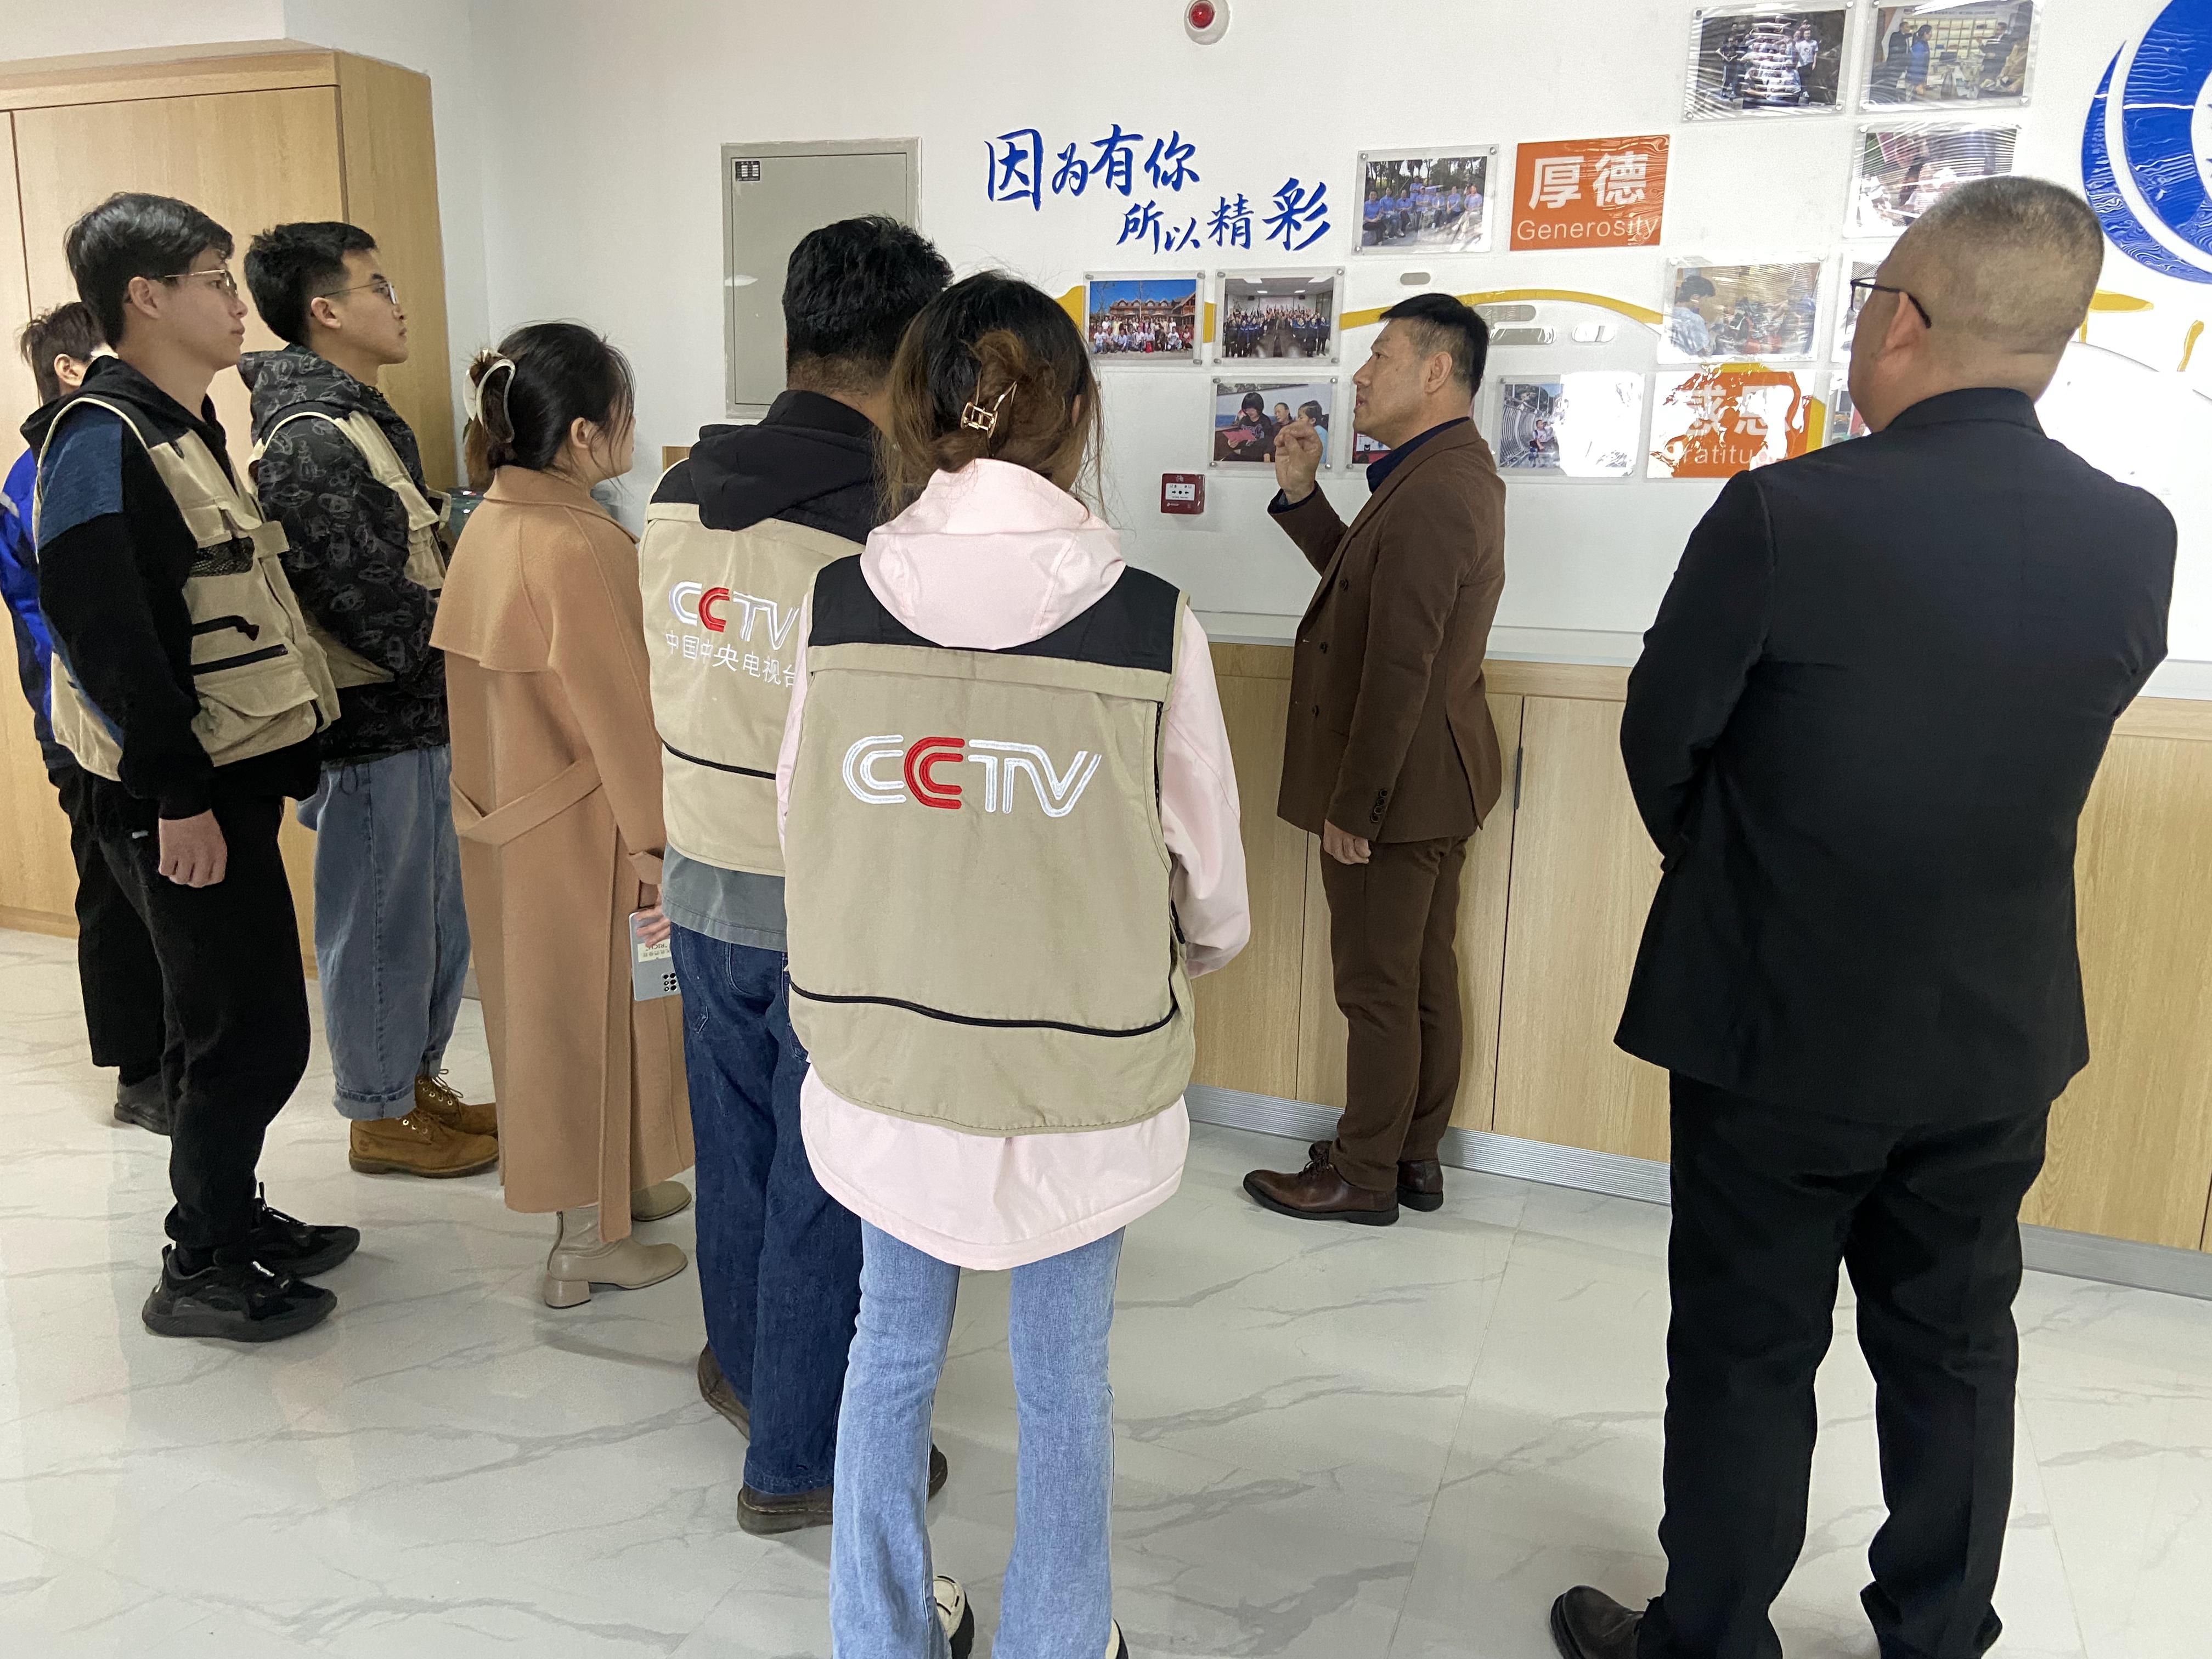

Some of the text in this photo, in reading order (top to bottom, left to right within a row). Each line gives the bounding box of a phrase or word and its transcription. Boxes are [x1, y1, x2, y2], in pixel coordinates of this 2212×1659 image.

[985, 124, 1200, 211] 因为有你
[1528, 150, 1648, 210] 厚德
[1116, 178, 1331, 255] 所以精彩
[1517, 216, 1658, 241] Generosity
[1680, 443, 1776, 464] ratitu
[668, 581, 799, 650] CCTV
[666, 630, 795, 687] 中国中央电视台
[842, 735, 1102, 817] CCTV
